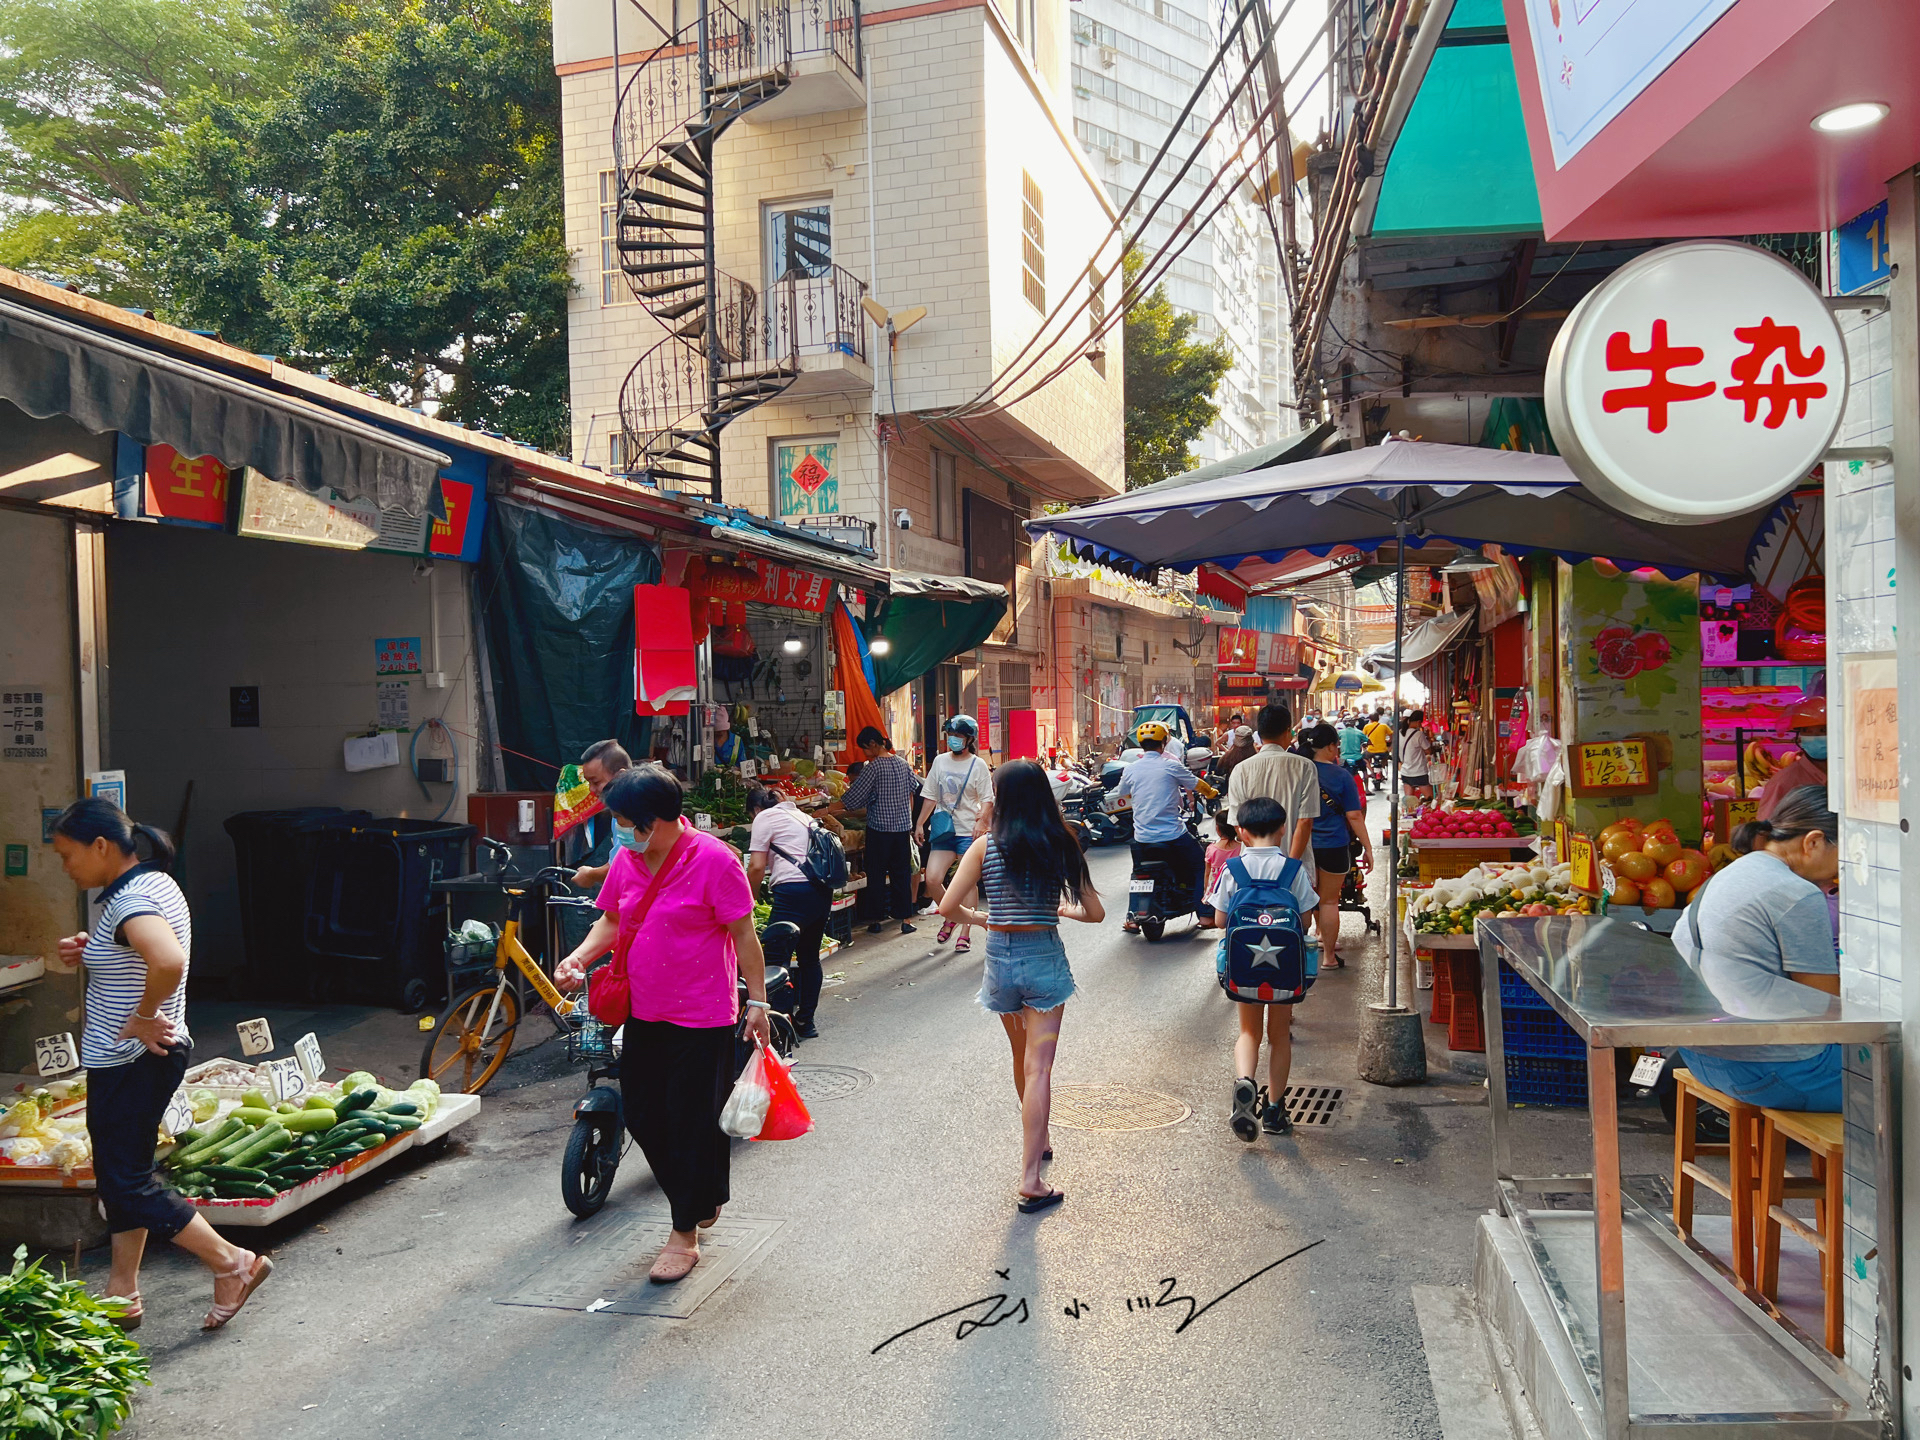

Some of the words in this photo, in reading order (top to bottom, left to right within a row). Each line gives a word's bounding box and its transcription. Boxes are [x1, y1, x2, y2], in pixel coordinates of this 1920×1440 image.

[1602, 317, 1828, 434] 牛杂
[799, 464, 821, 487] 福
[3, 706, 44, 718] 一厅二房
[3, 720, 44, 731] 一厅一房
[15, 734, 35, 745] 单间
